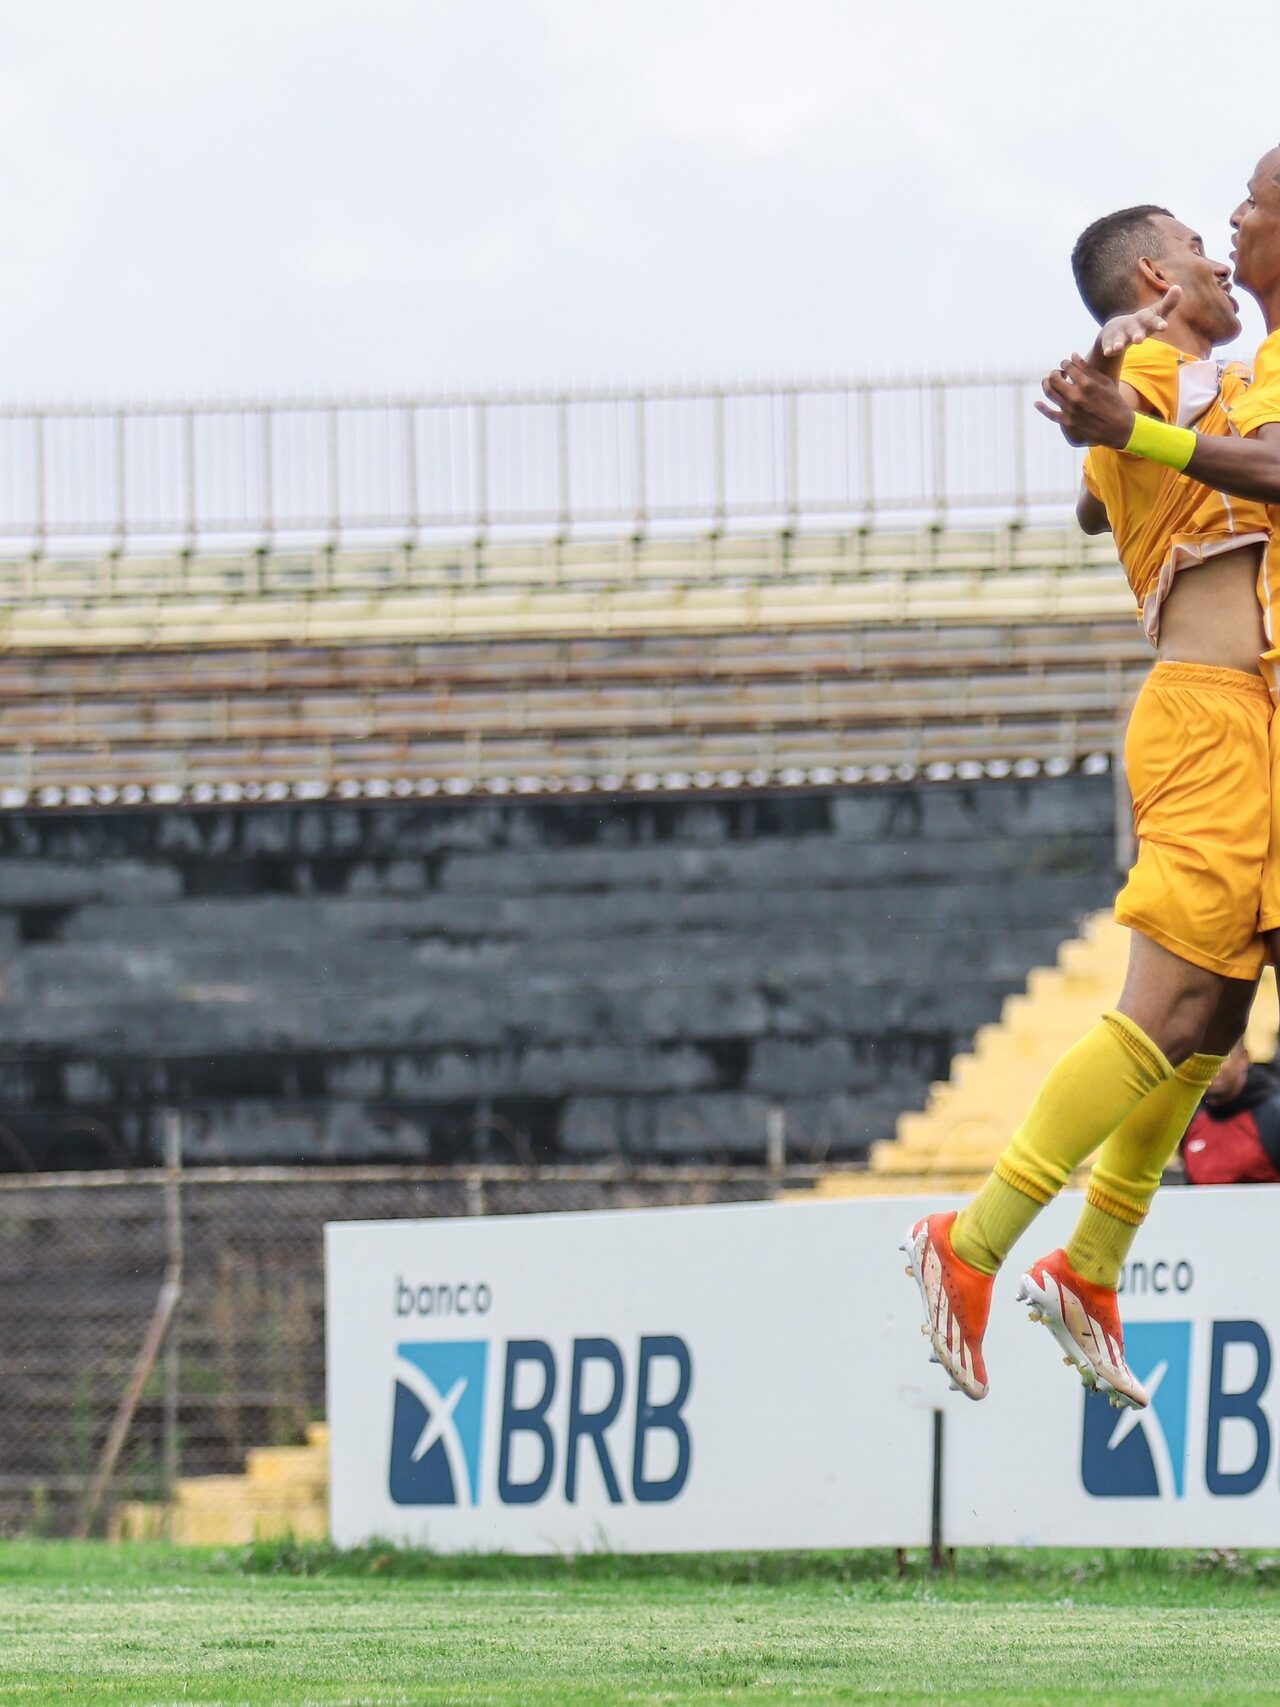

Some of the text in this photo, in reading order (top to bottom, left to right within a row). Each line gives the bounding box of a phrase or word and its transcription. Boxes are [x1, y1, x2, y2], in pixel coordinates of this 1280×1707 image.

[395, 1274, 492, 1317] banco
[1116, 1260, 1195, 1294] nco
[497, 1335, 693, 1506] BRB
